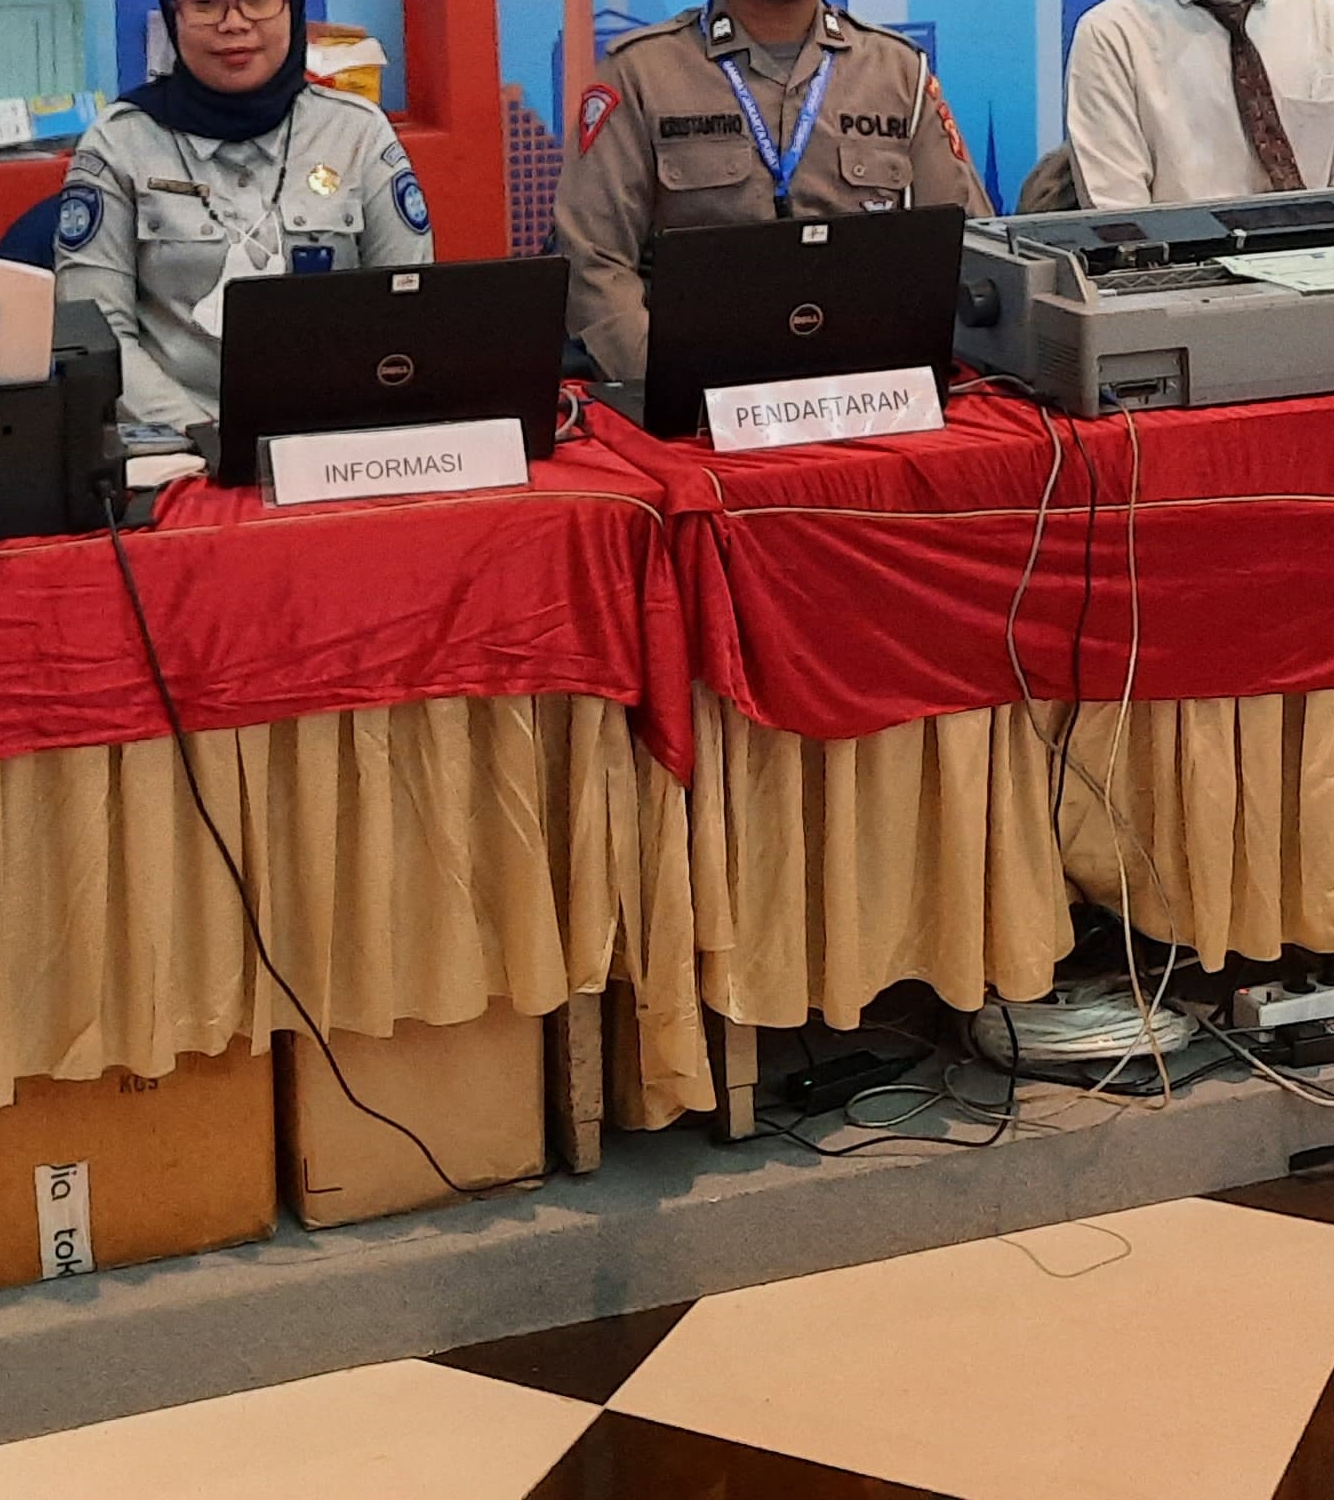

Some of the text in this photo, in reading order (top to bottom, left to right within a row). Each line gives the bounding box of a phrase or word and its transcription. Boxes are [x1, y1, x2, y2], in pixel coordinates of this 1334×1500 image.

[840, 113, 909, 139] POLRI
[736, 389, 909, 428] PENDAFTARAN
[325, 452, 463, 483] INFORMASI
